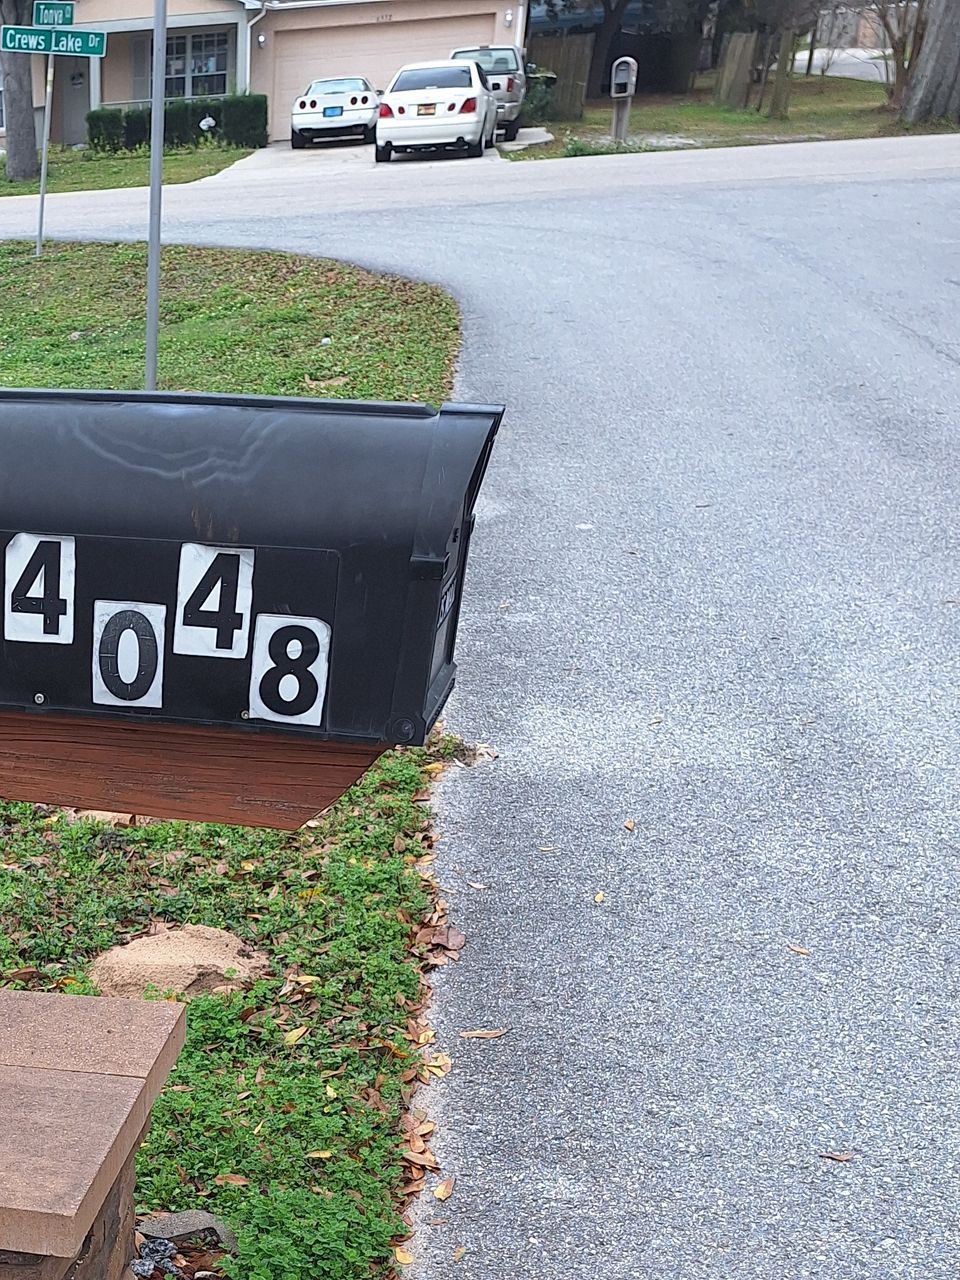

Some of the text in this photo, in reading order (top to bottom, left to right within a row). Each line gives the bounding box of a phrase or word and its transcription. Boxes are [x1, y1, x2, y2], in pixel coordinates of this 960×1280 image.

[6, 29, 100, 52] Crews Lake Dr
[11, 540, 319, 716] 4048
